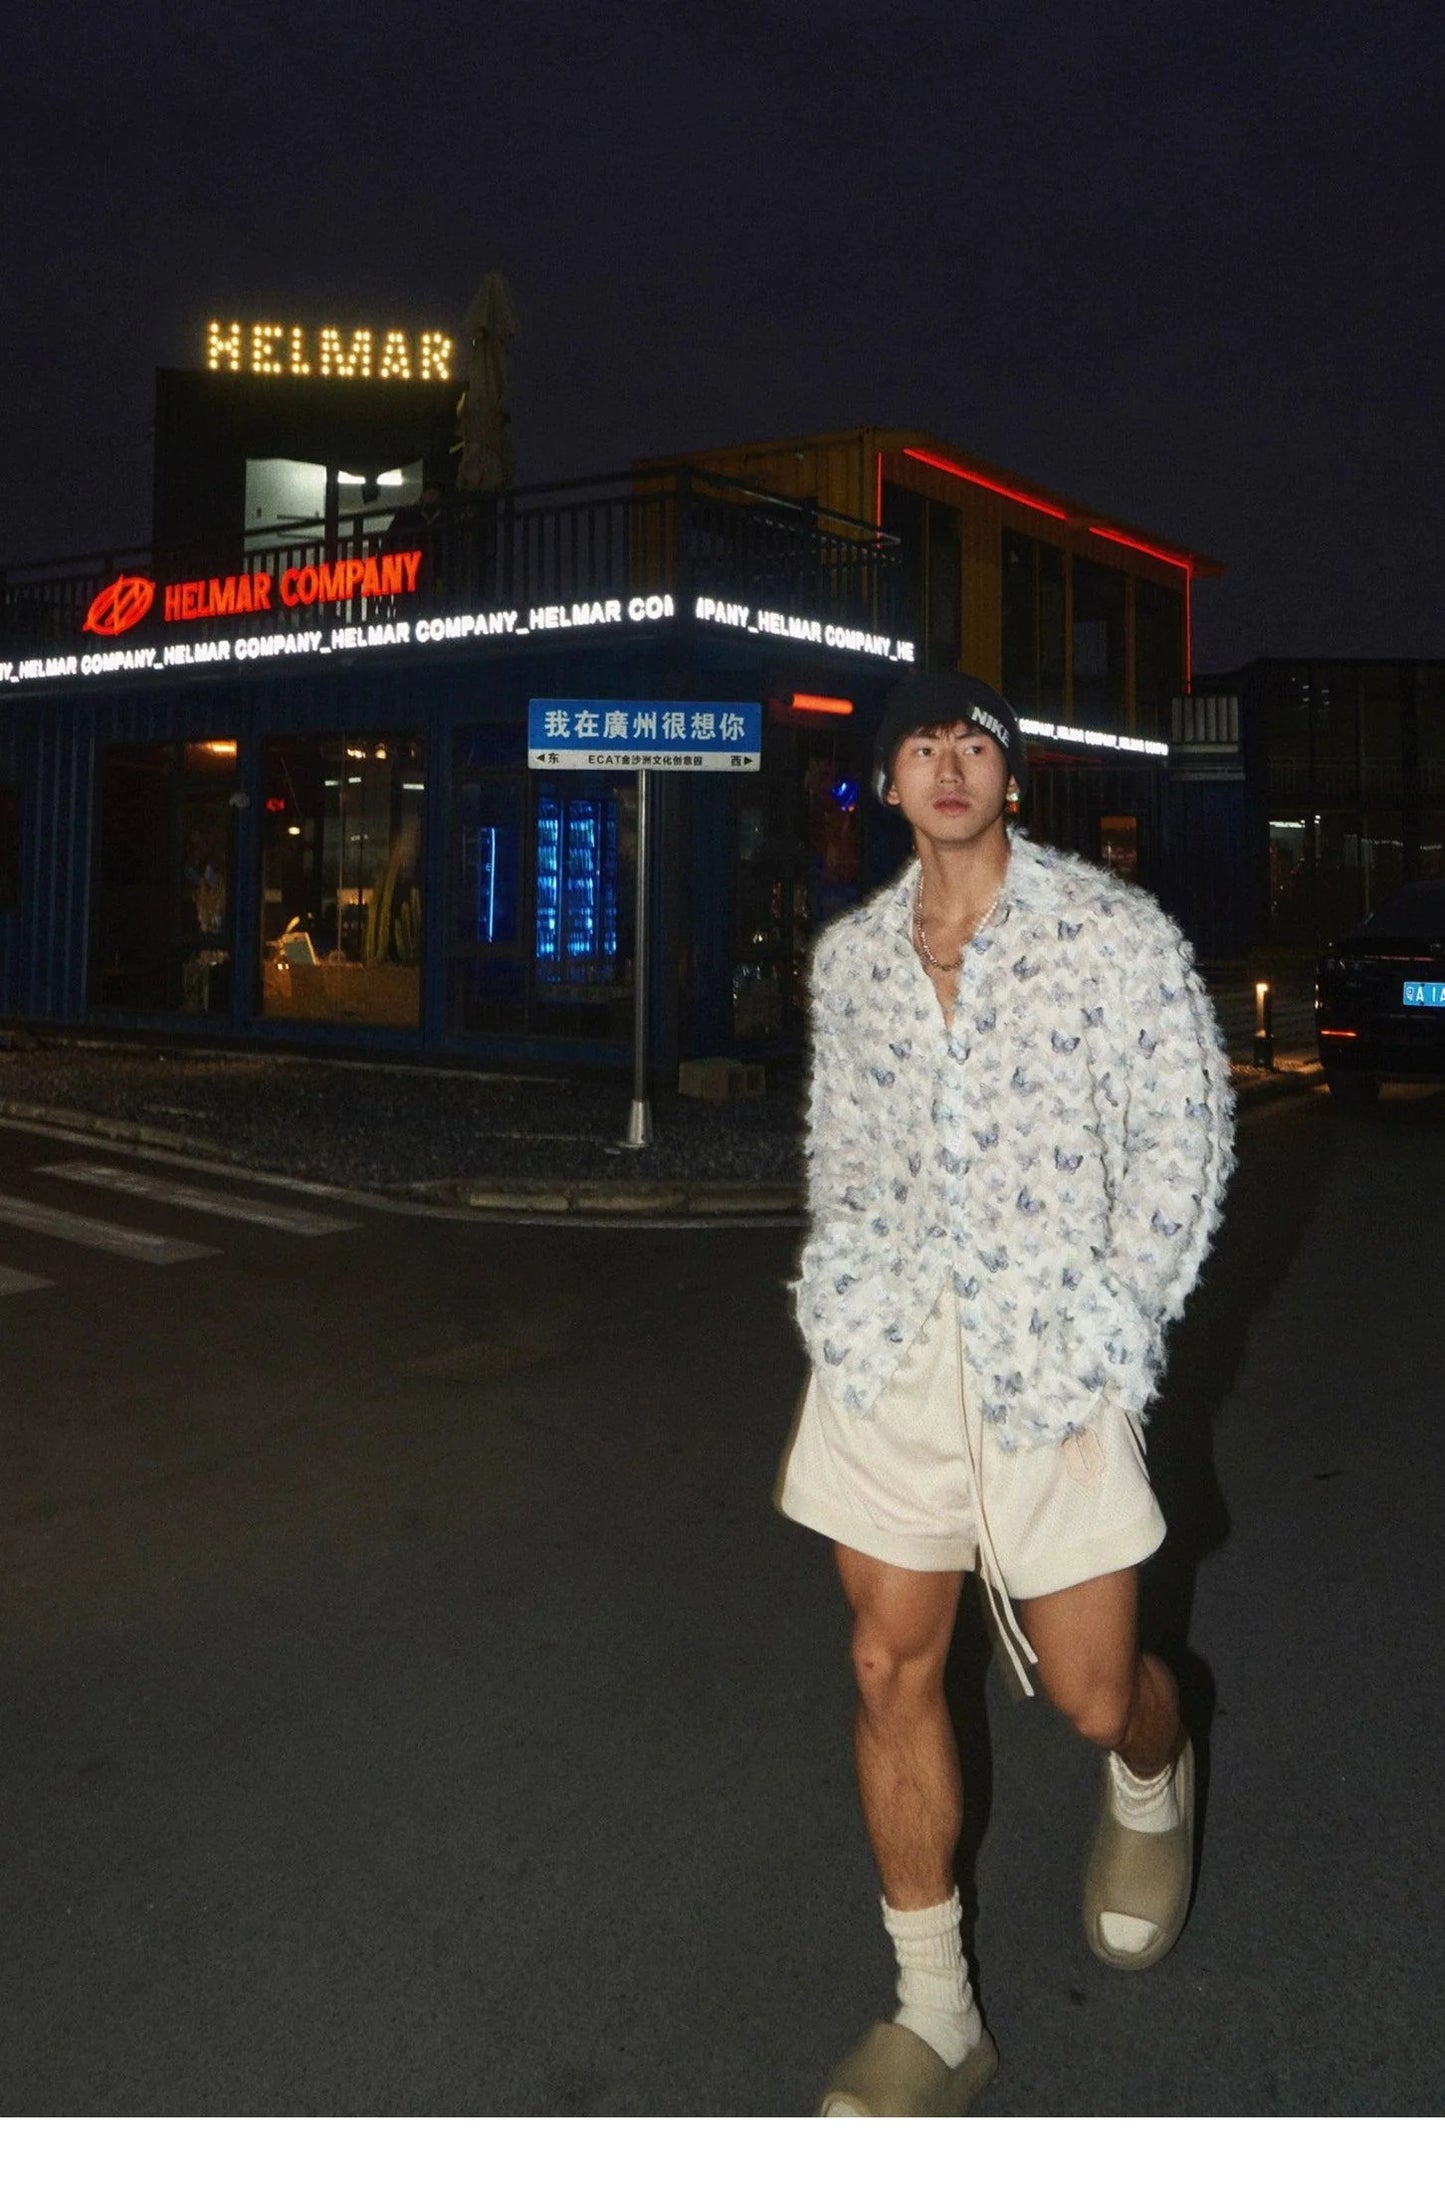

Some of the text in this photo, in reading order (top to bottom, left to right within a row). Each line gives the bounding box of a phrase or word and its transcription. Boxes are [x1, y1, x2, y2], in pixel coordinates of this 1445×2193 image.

[207, 319, 454, 380] HELMAR
[164, 551, 422, 622] HELMAR COMPANY
[544, 709, 745, 741] 我在廣州很想你
[971, 706, 1010, 749] NIKE
[548, 752, 560, 764] 东
[730, 755, 742, 767] 西
